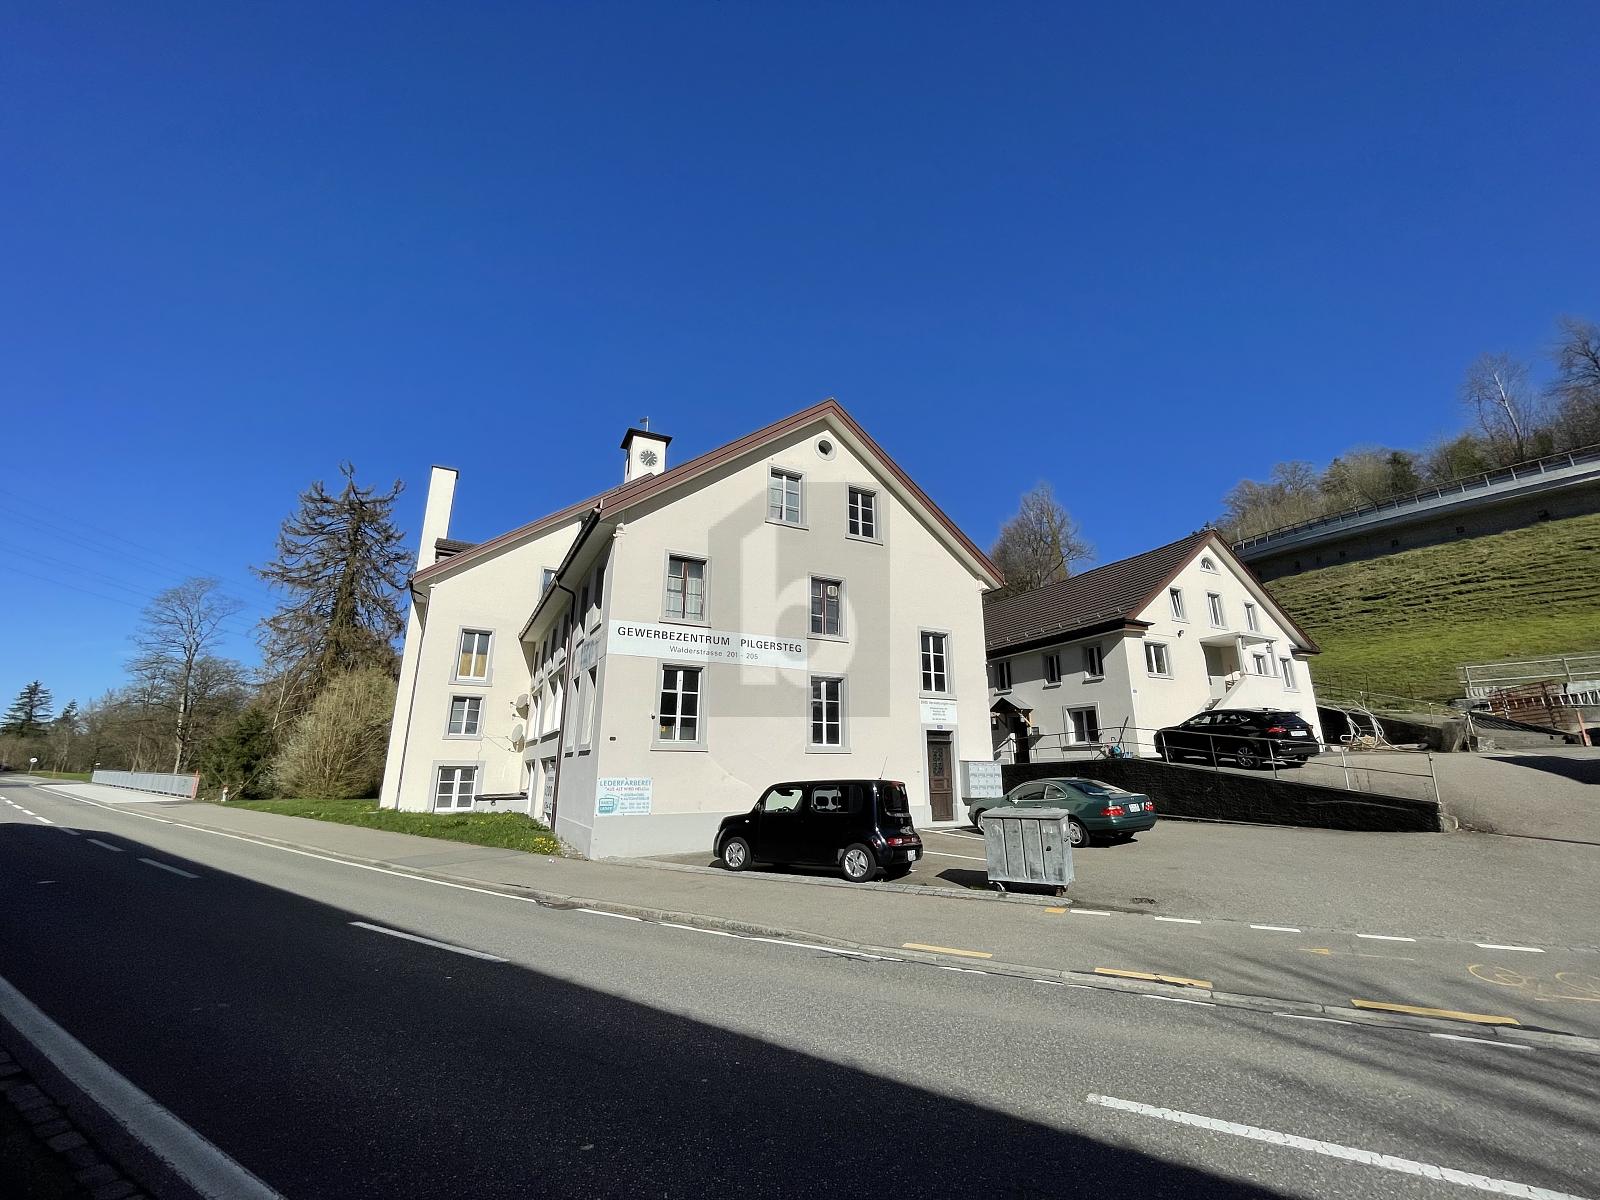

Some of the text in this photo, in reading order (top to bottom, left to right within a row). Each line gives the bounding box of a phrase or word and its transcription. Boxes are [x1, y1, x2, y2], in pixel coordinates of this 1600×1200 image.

[617, 626, 802, 653] GEWERBEZENTRUM PILGERSTEG
[669, 645, 723, 657] Walderstrasse
[726, 650, 738, 658] 201
[746, 652, 759, 660] 205
